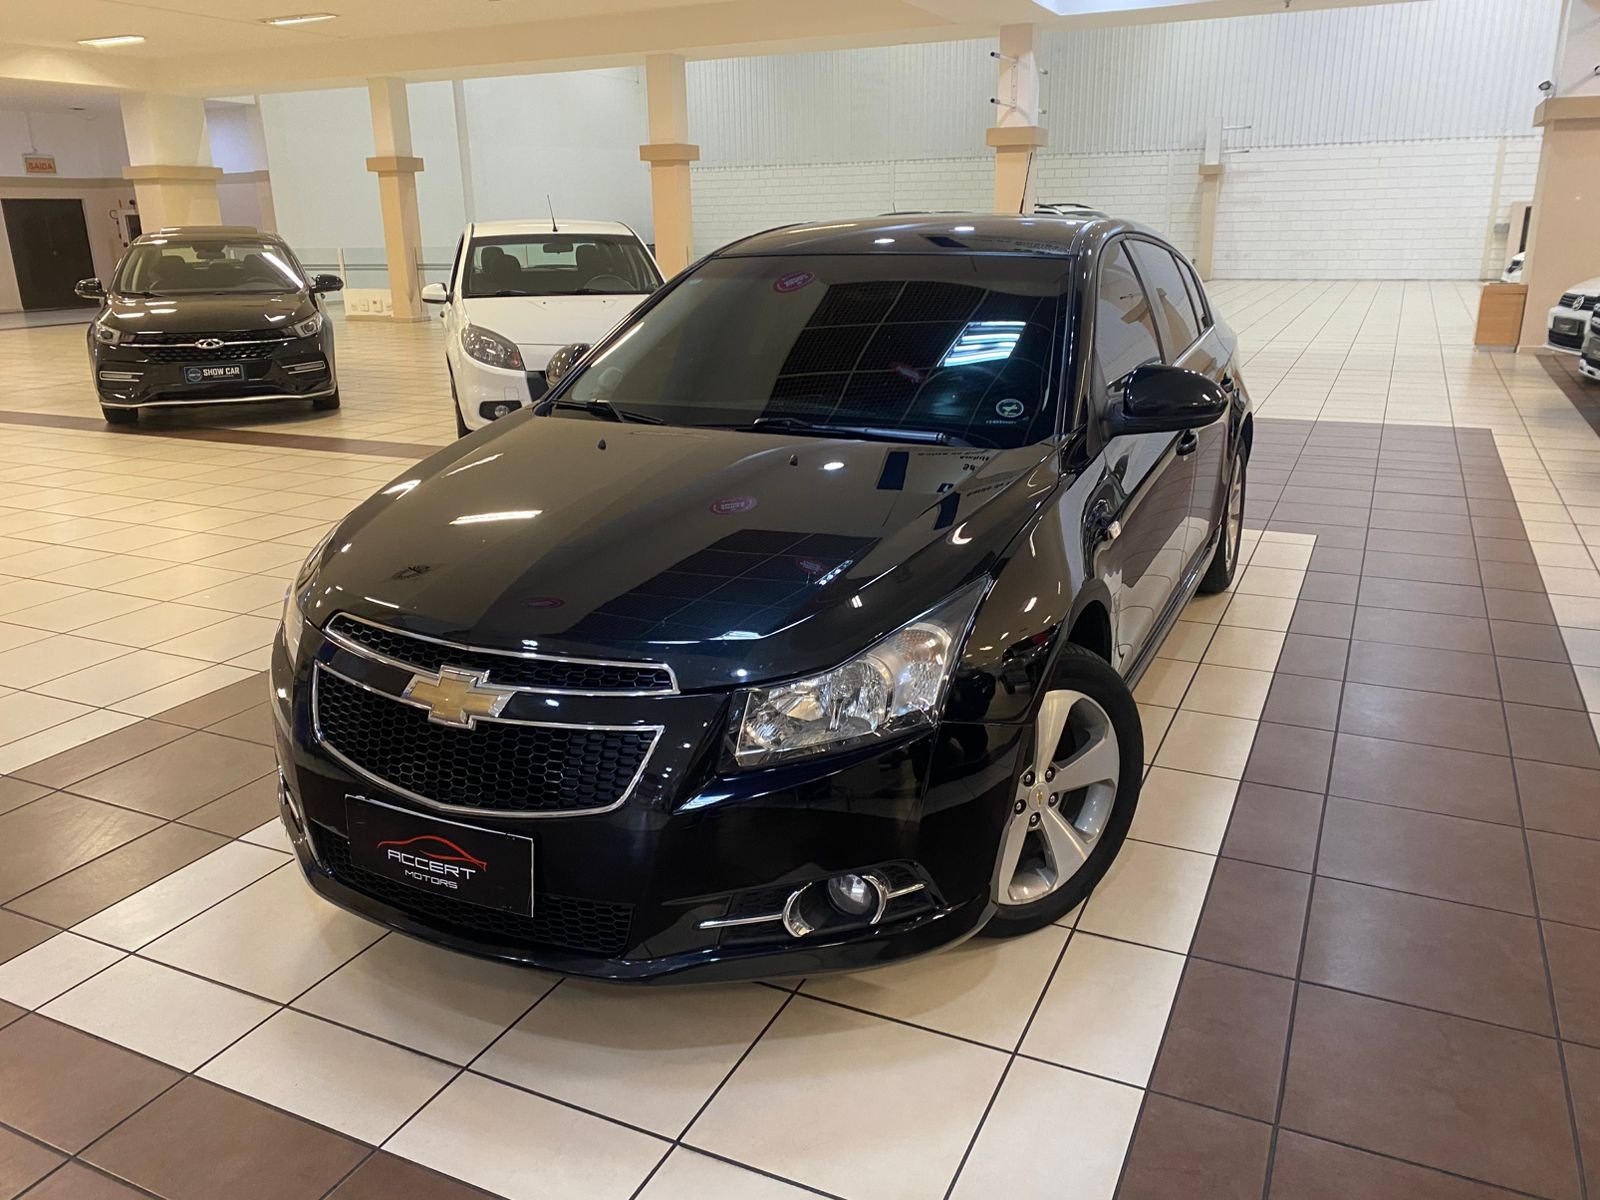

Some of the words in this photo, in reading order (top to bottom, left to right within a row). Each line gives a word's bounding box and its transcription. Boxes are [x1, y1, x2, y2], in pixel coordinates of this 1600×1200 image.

[203, 368, 224, 377] SHOW
[225, 367, 240, 375] CAR
[387, 849, 476, 880] ACCERT
[404, 869, 458, 889] MOTORS
